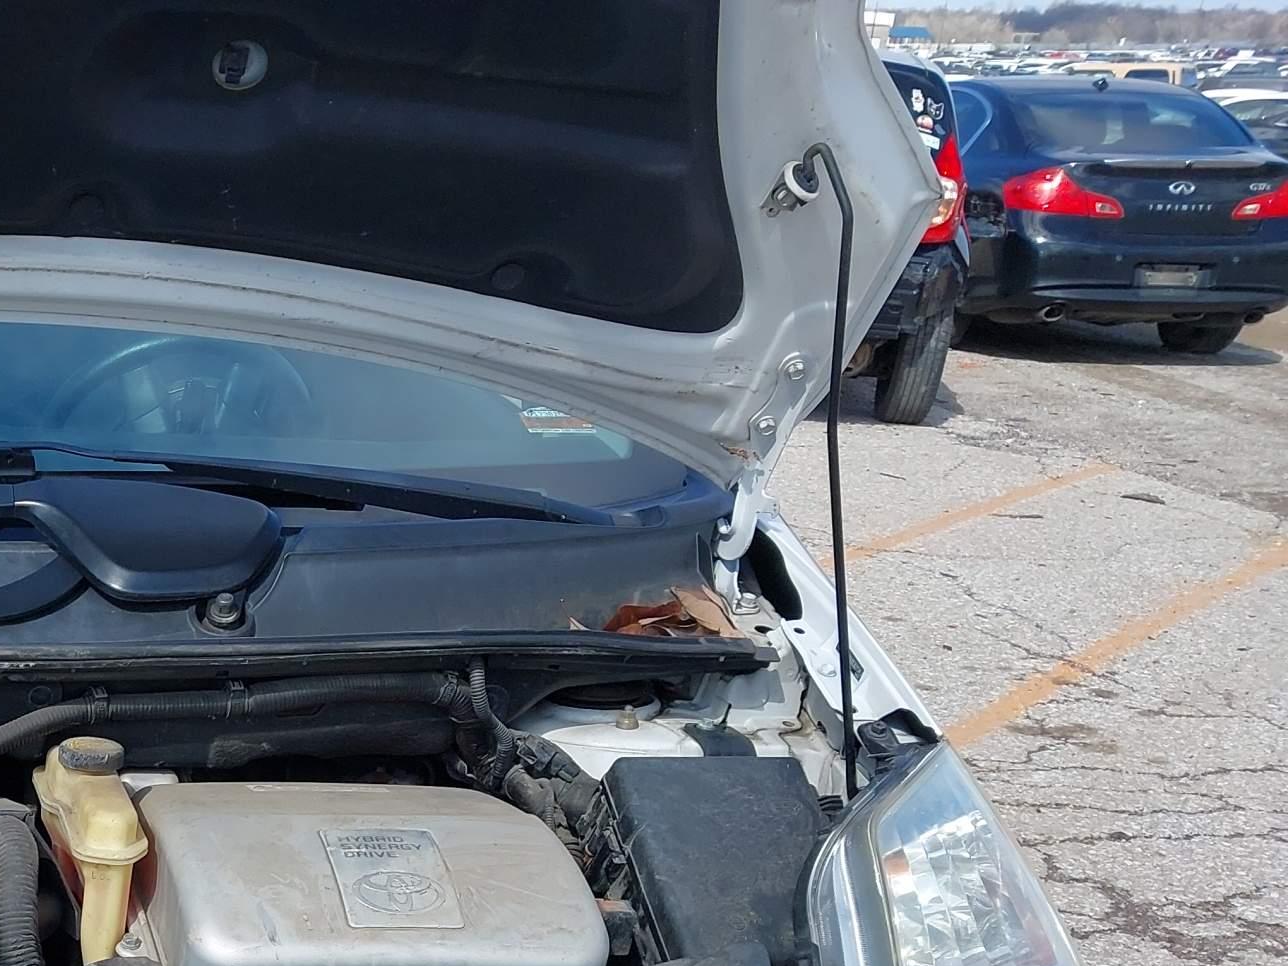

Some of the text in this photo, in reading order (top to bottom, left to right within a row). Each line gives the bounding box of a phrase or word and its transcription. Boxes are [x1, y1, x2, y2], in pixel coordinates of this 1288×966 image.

[1148, 203, 1213, 212] INFINITI
[337, 835, 405, 843] HYBRID
[340, 842, 423, 851] SYNERGY
[343, 850, 400, 859] DRIVE
